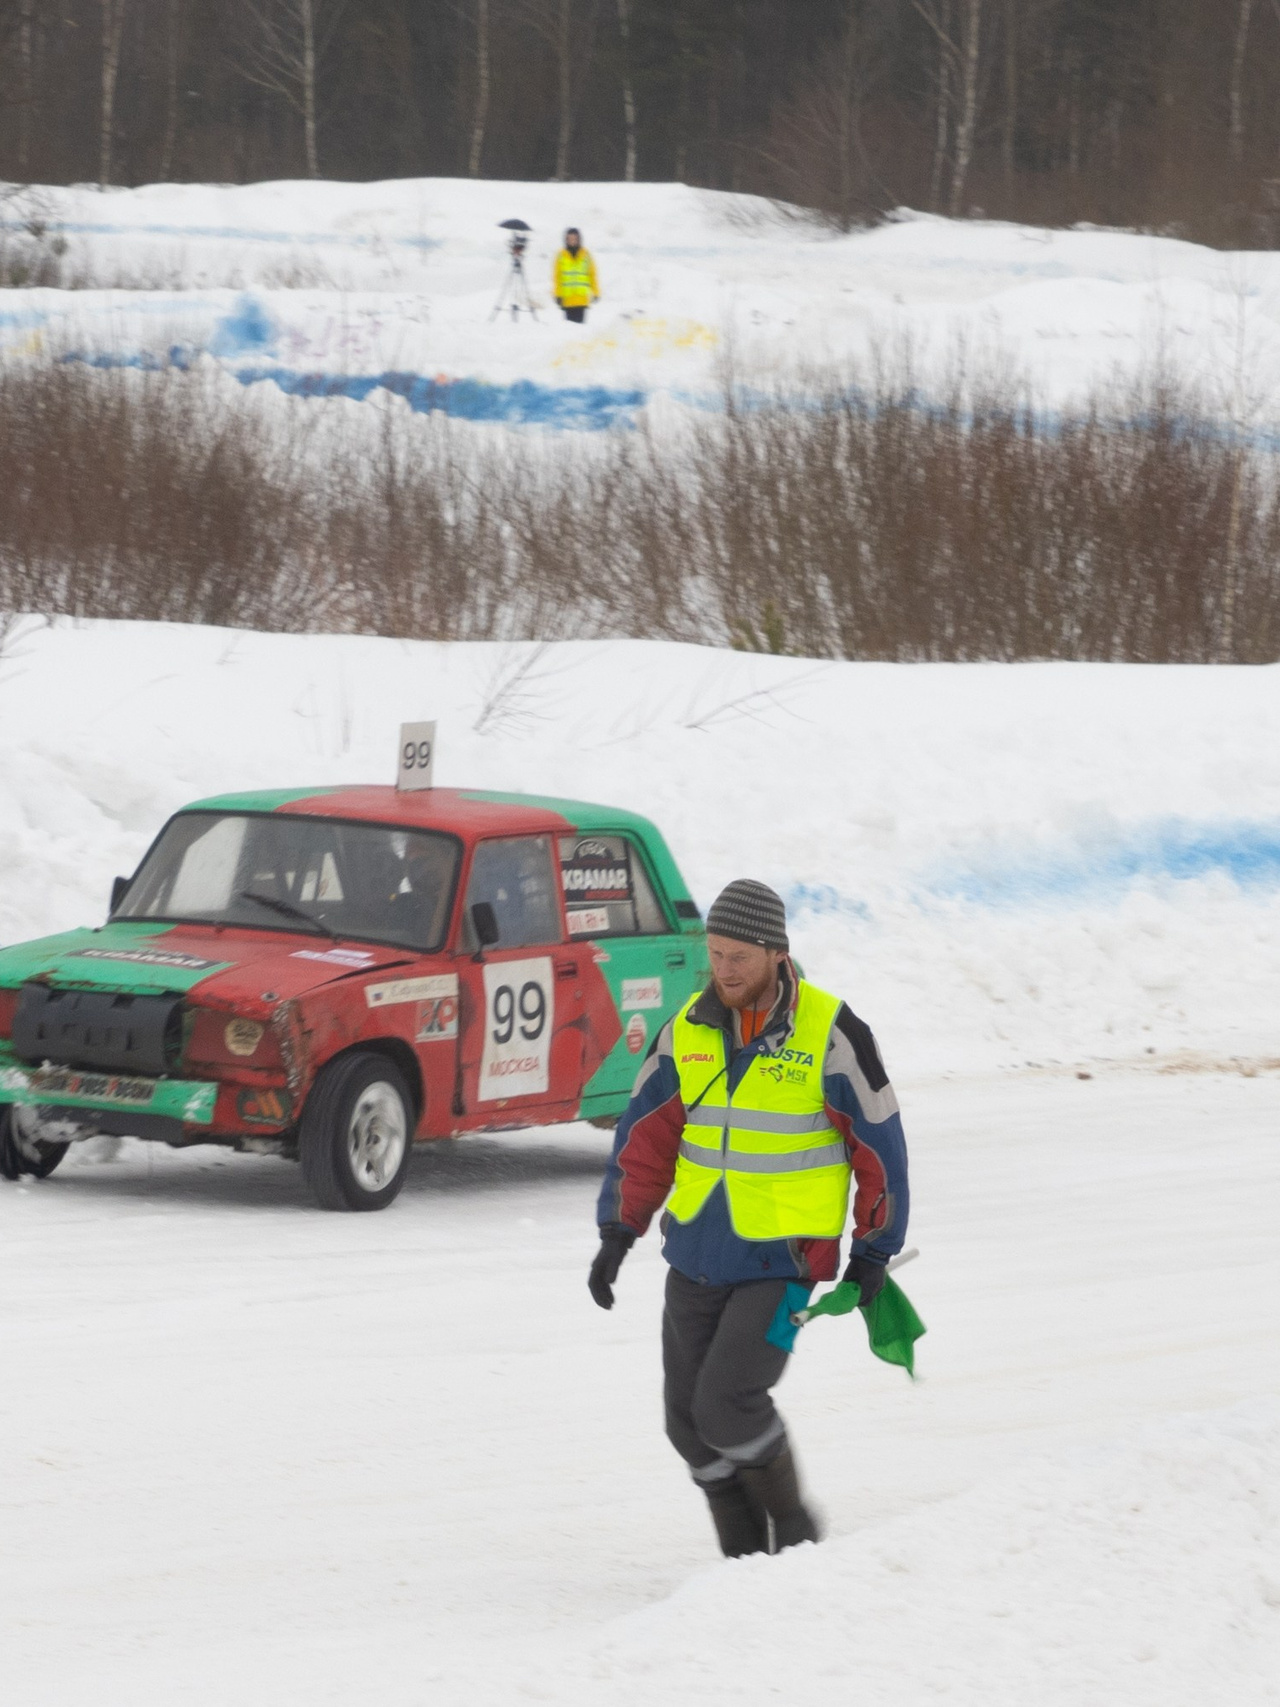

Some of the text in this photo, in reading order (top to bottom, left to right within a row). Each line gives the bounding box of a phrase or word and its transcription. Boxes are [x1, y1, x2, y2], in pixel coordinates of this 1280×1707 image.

[403, 741, 431, 770] 99
[561, 868, 627, 890] KRAMAR
[493, 981, 546, 1045] 99
[488, 1056, 540, 1078] МОСКВА
[786, 1068, 808, 1082] MSK
